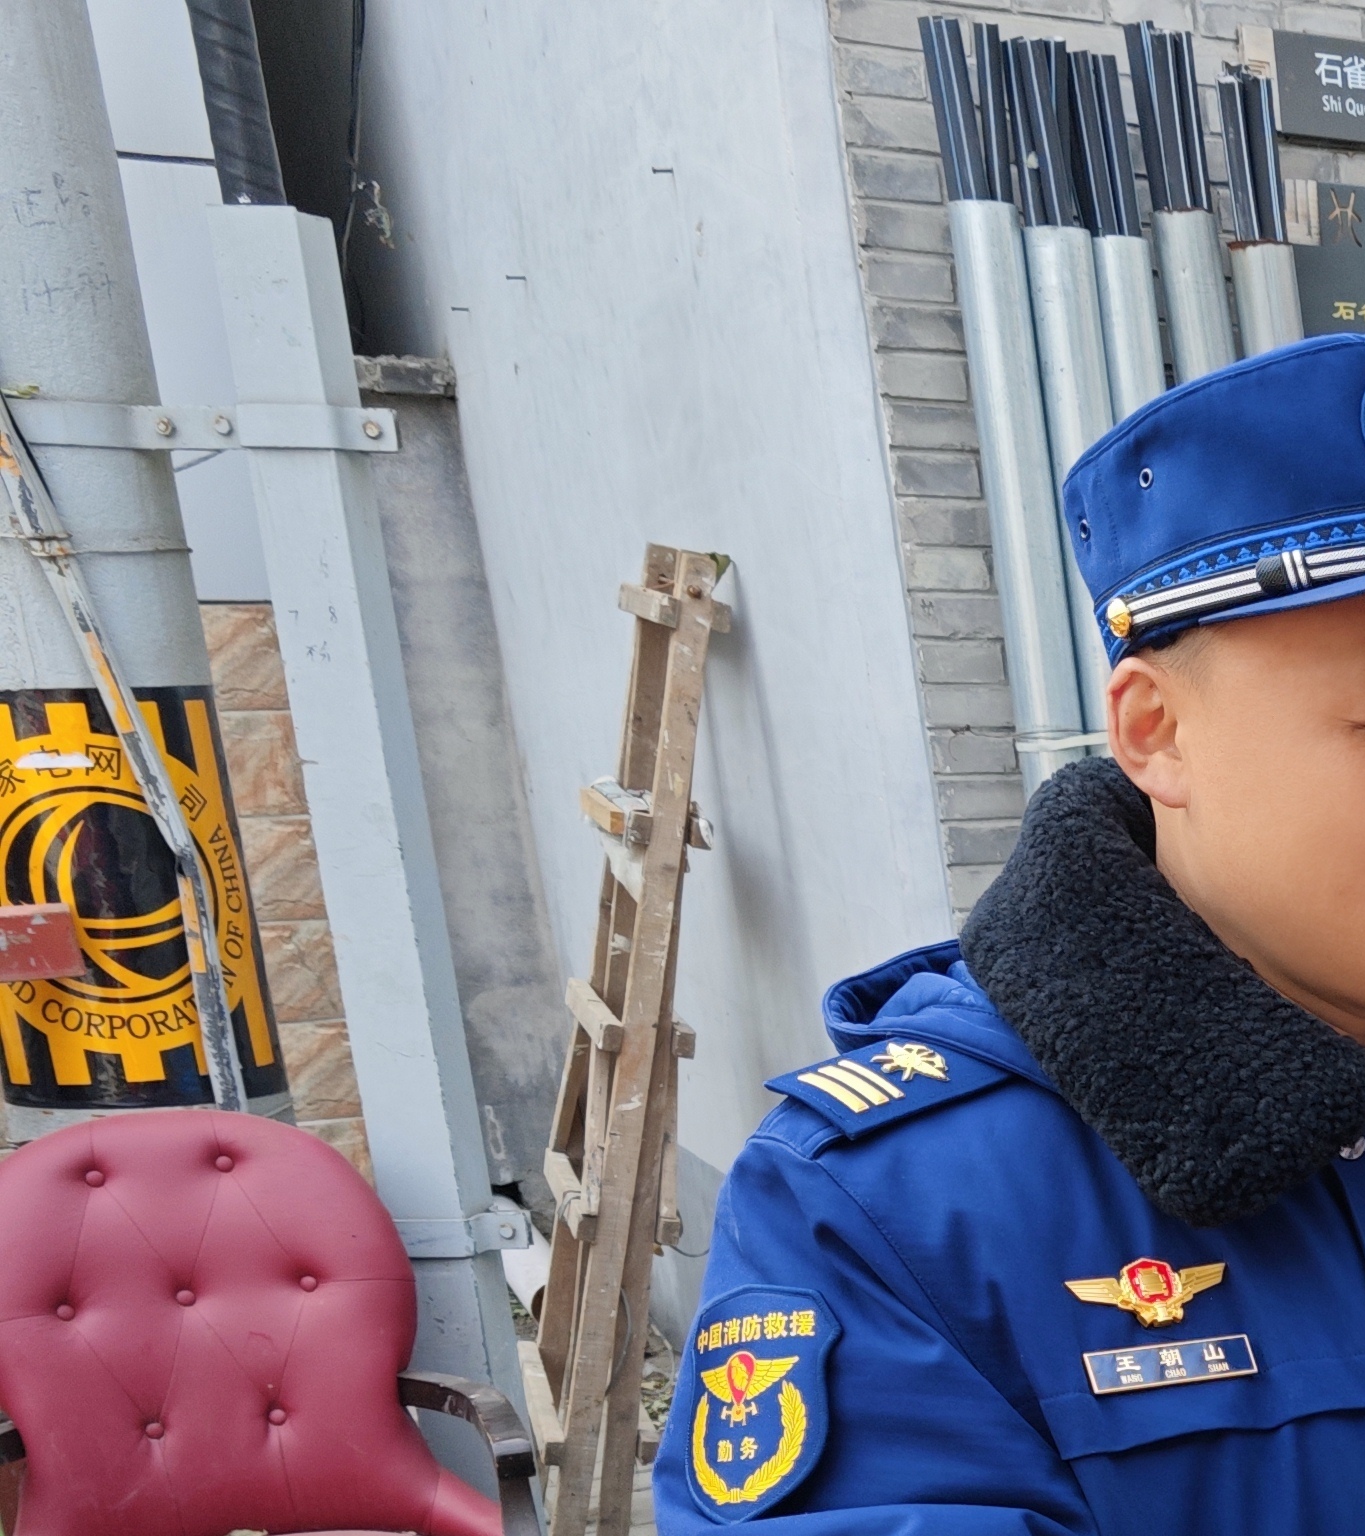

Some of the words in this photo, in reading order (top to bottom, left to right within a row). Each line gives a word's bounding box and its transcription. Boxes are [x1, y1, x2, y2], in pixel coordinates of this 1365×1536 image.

[1322, 95, 1342, 114] Shi
[208, 823, 243, 913] CHINA
[224, 920, 245, 960] OF
[697, 1310, 816, 1354] 中国消防救援
[717, 1437, 758, 1463] 勤务
